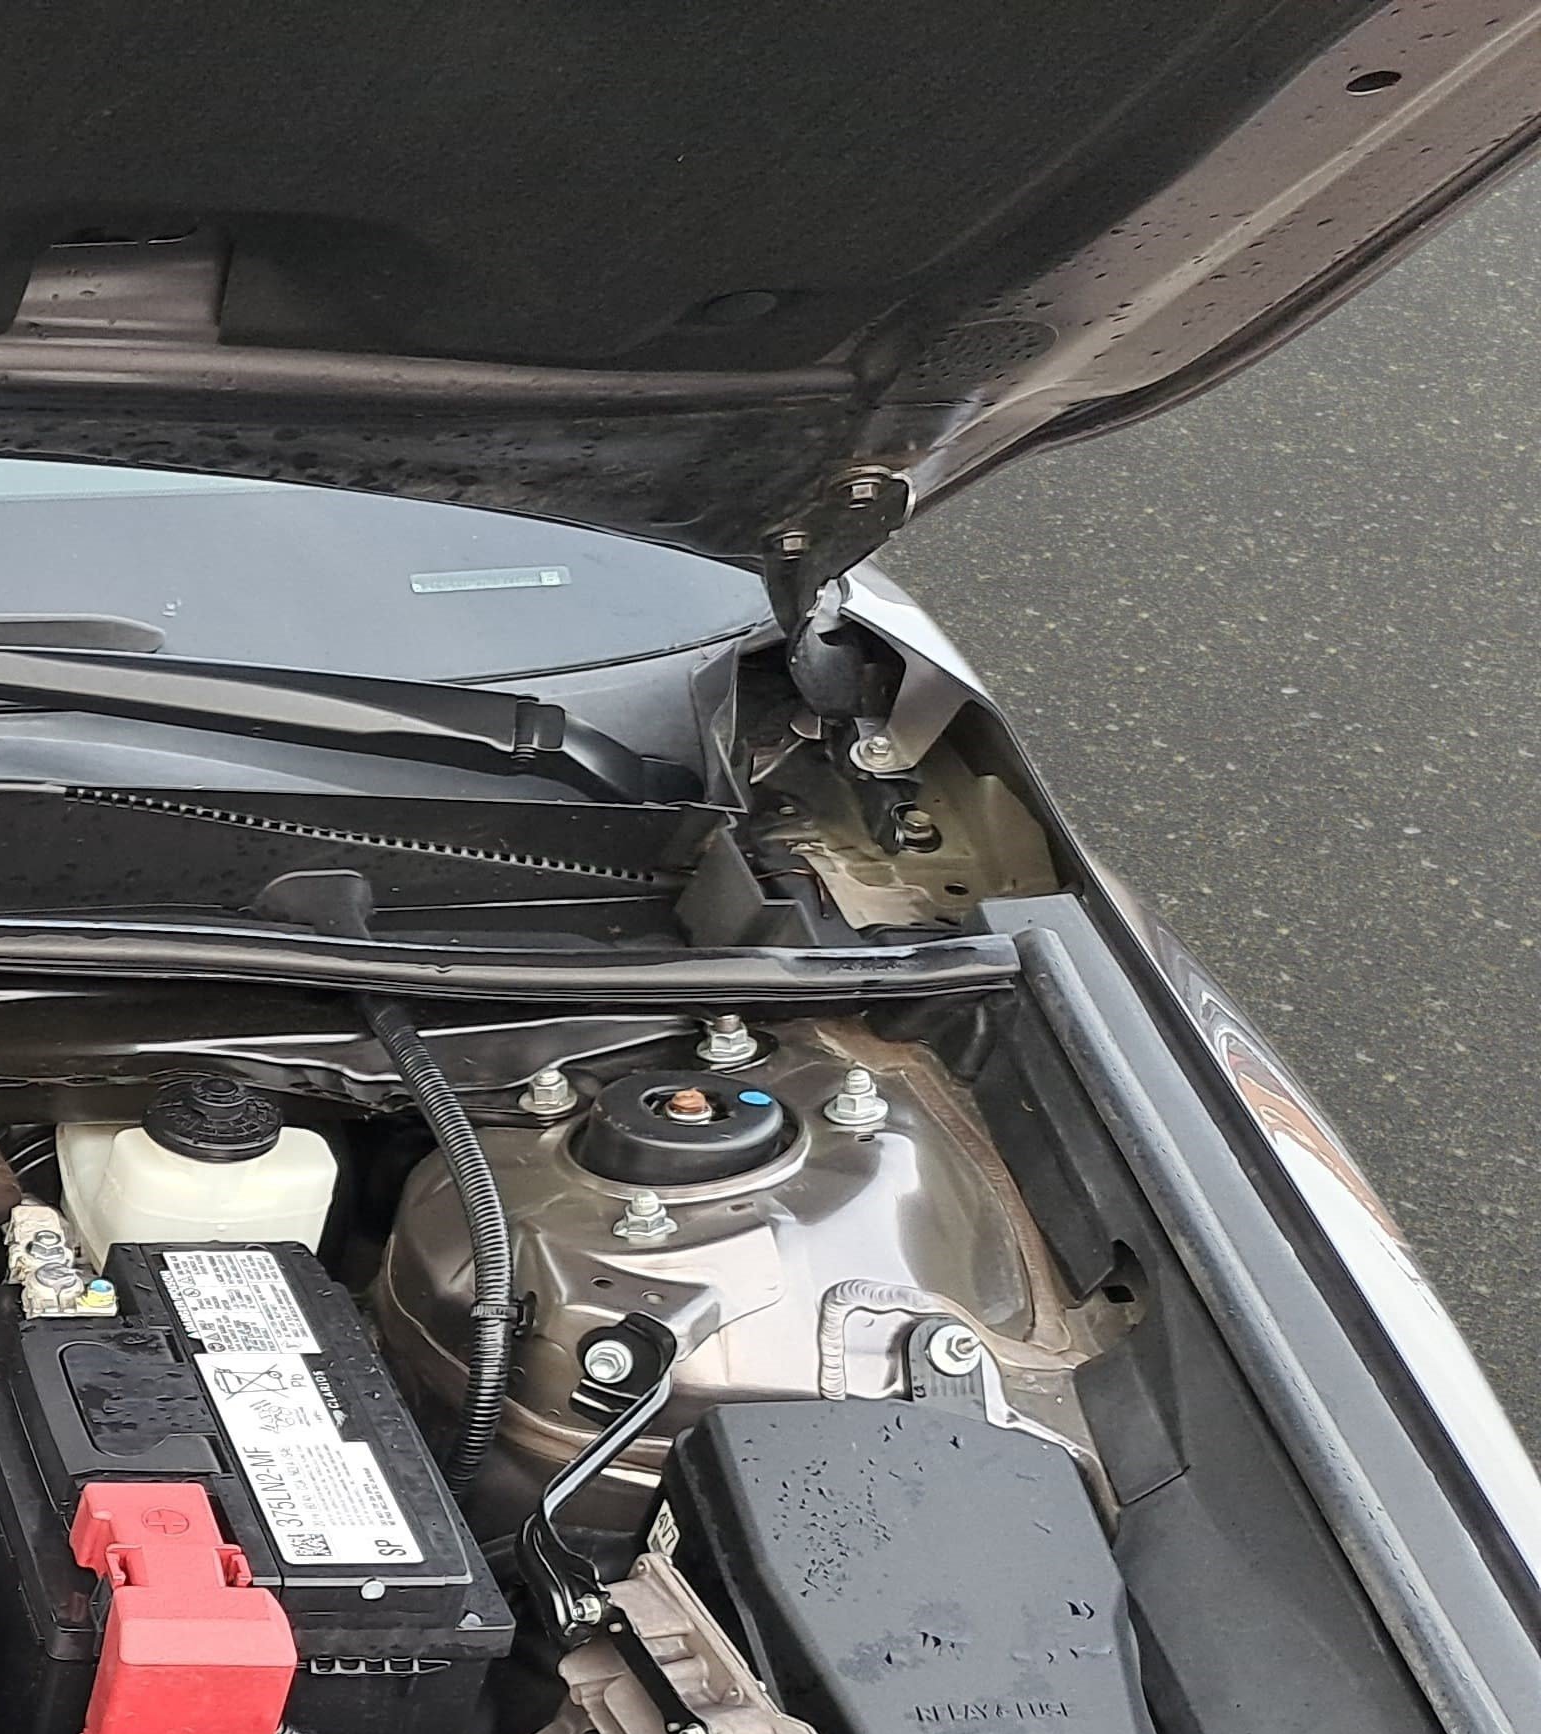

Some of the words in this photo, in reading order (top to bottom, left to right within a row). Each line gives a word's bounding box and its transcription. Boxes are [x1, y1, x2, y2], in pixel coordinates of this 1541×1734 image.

[313, 1370, 339, 1409] CLARIOS
[243, 1446, 303, 1527] 375LN2-MF
[374, 1539, 407, 1557] SP
